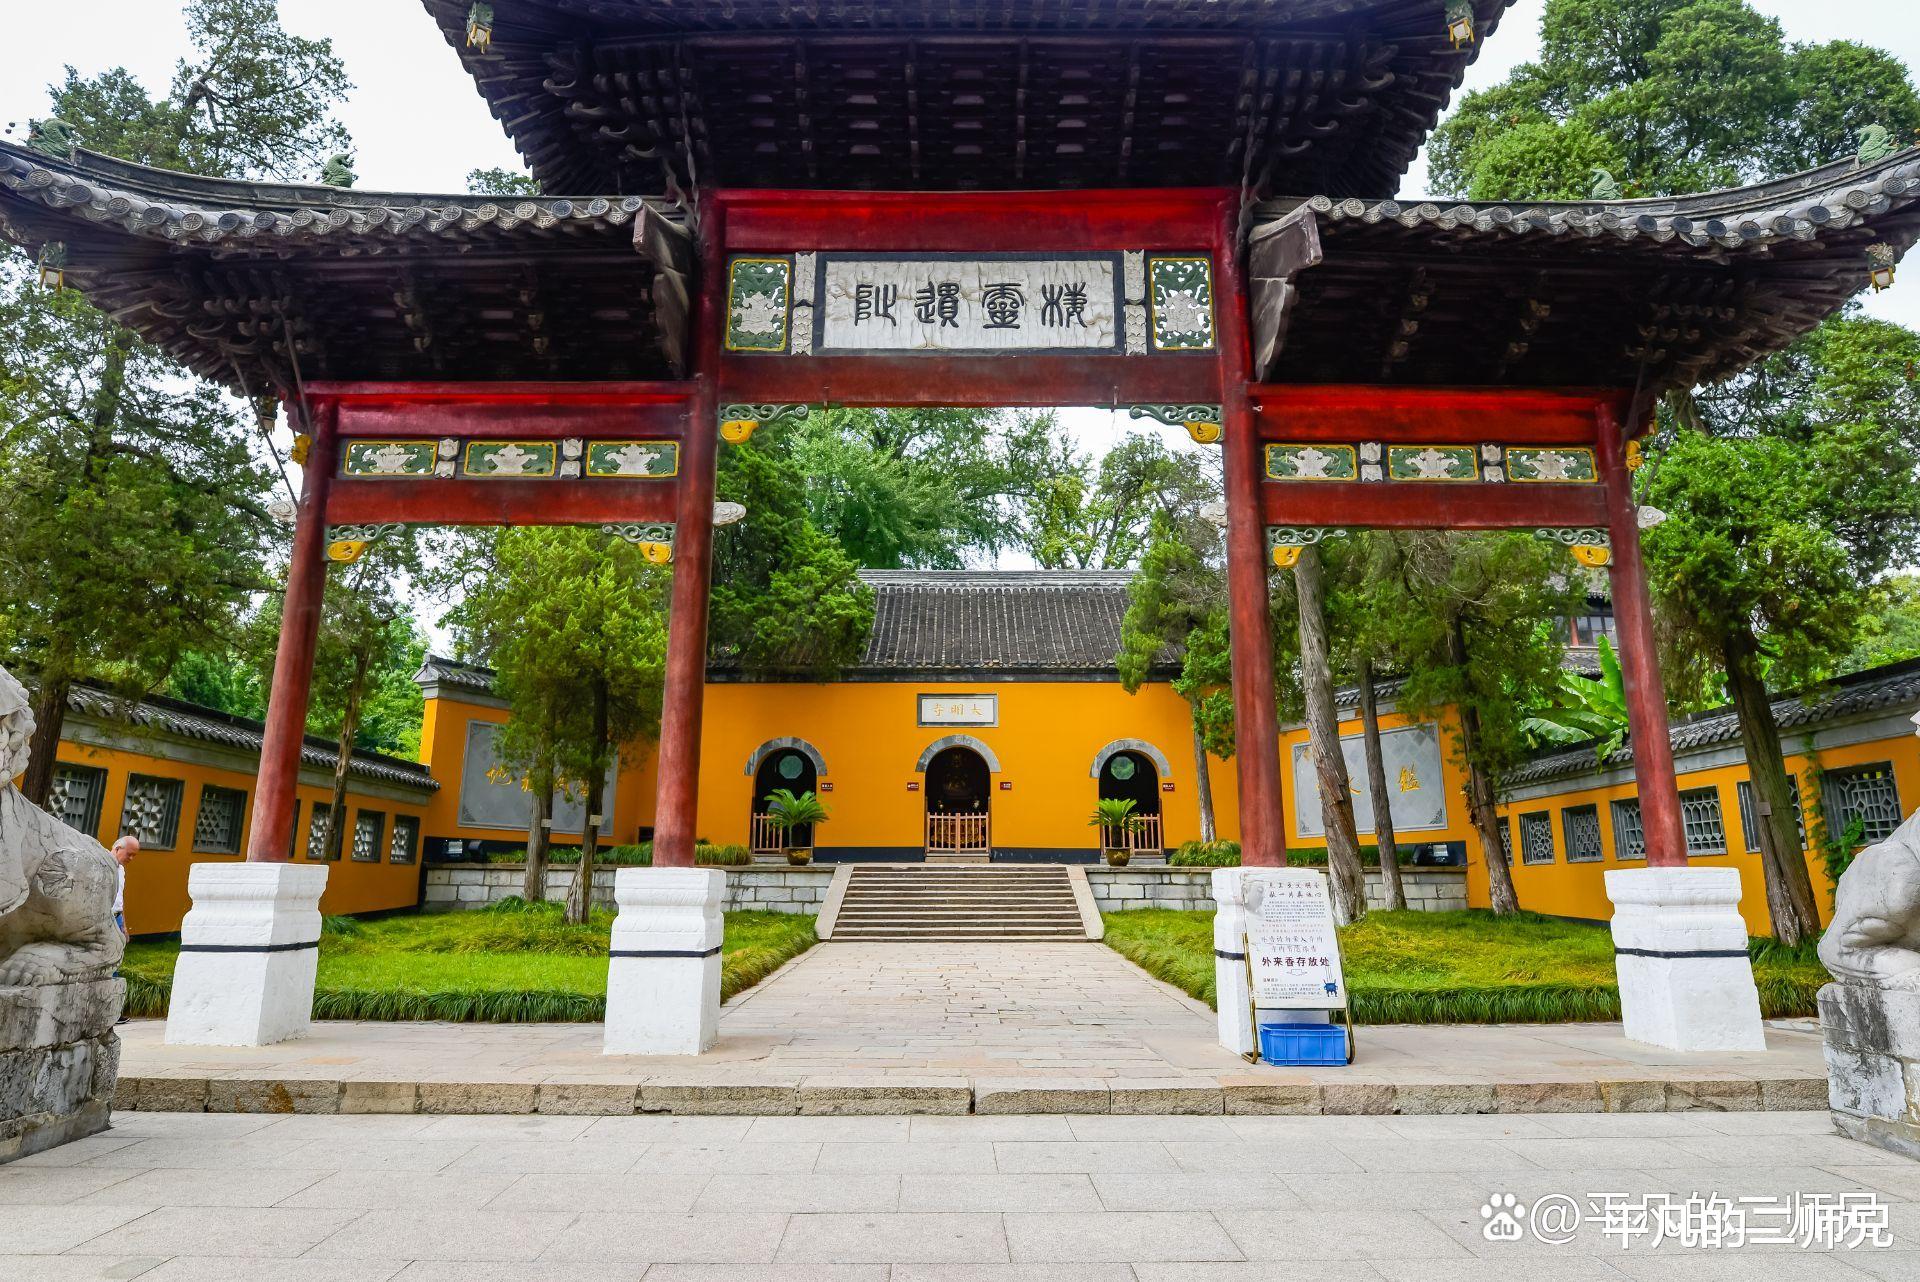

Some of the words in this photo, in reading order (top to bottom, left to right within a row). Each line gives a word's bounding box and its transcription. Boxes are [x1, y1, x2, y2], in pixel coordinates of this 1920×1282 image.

[1262, 956, 1330, 967] 外来香存放处
